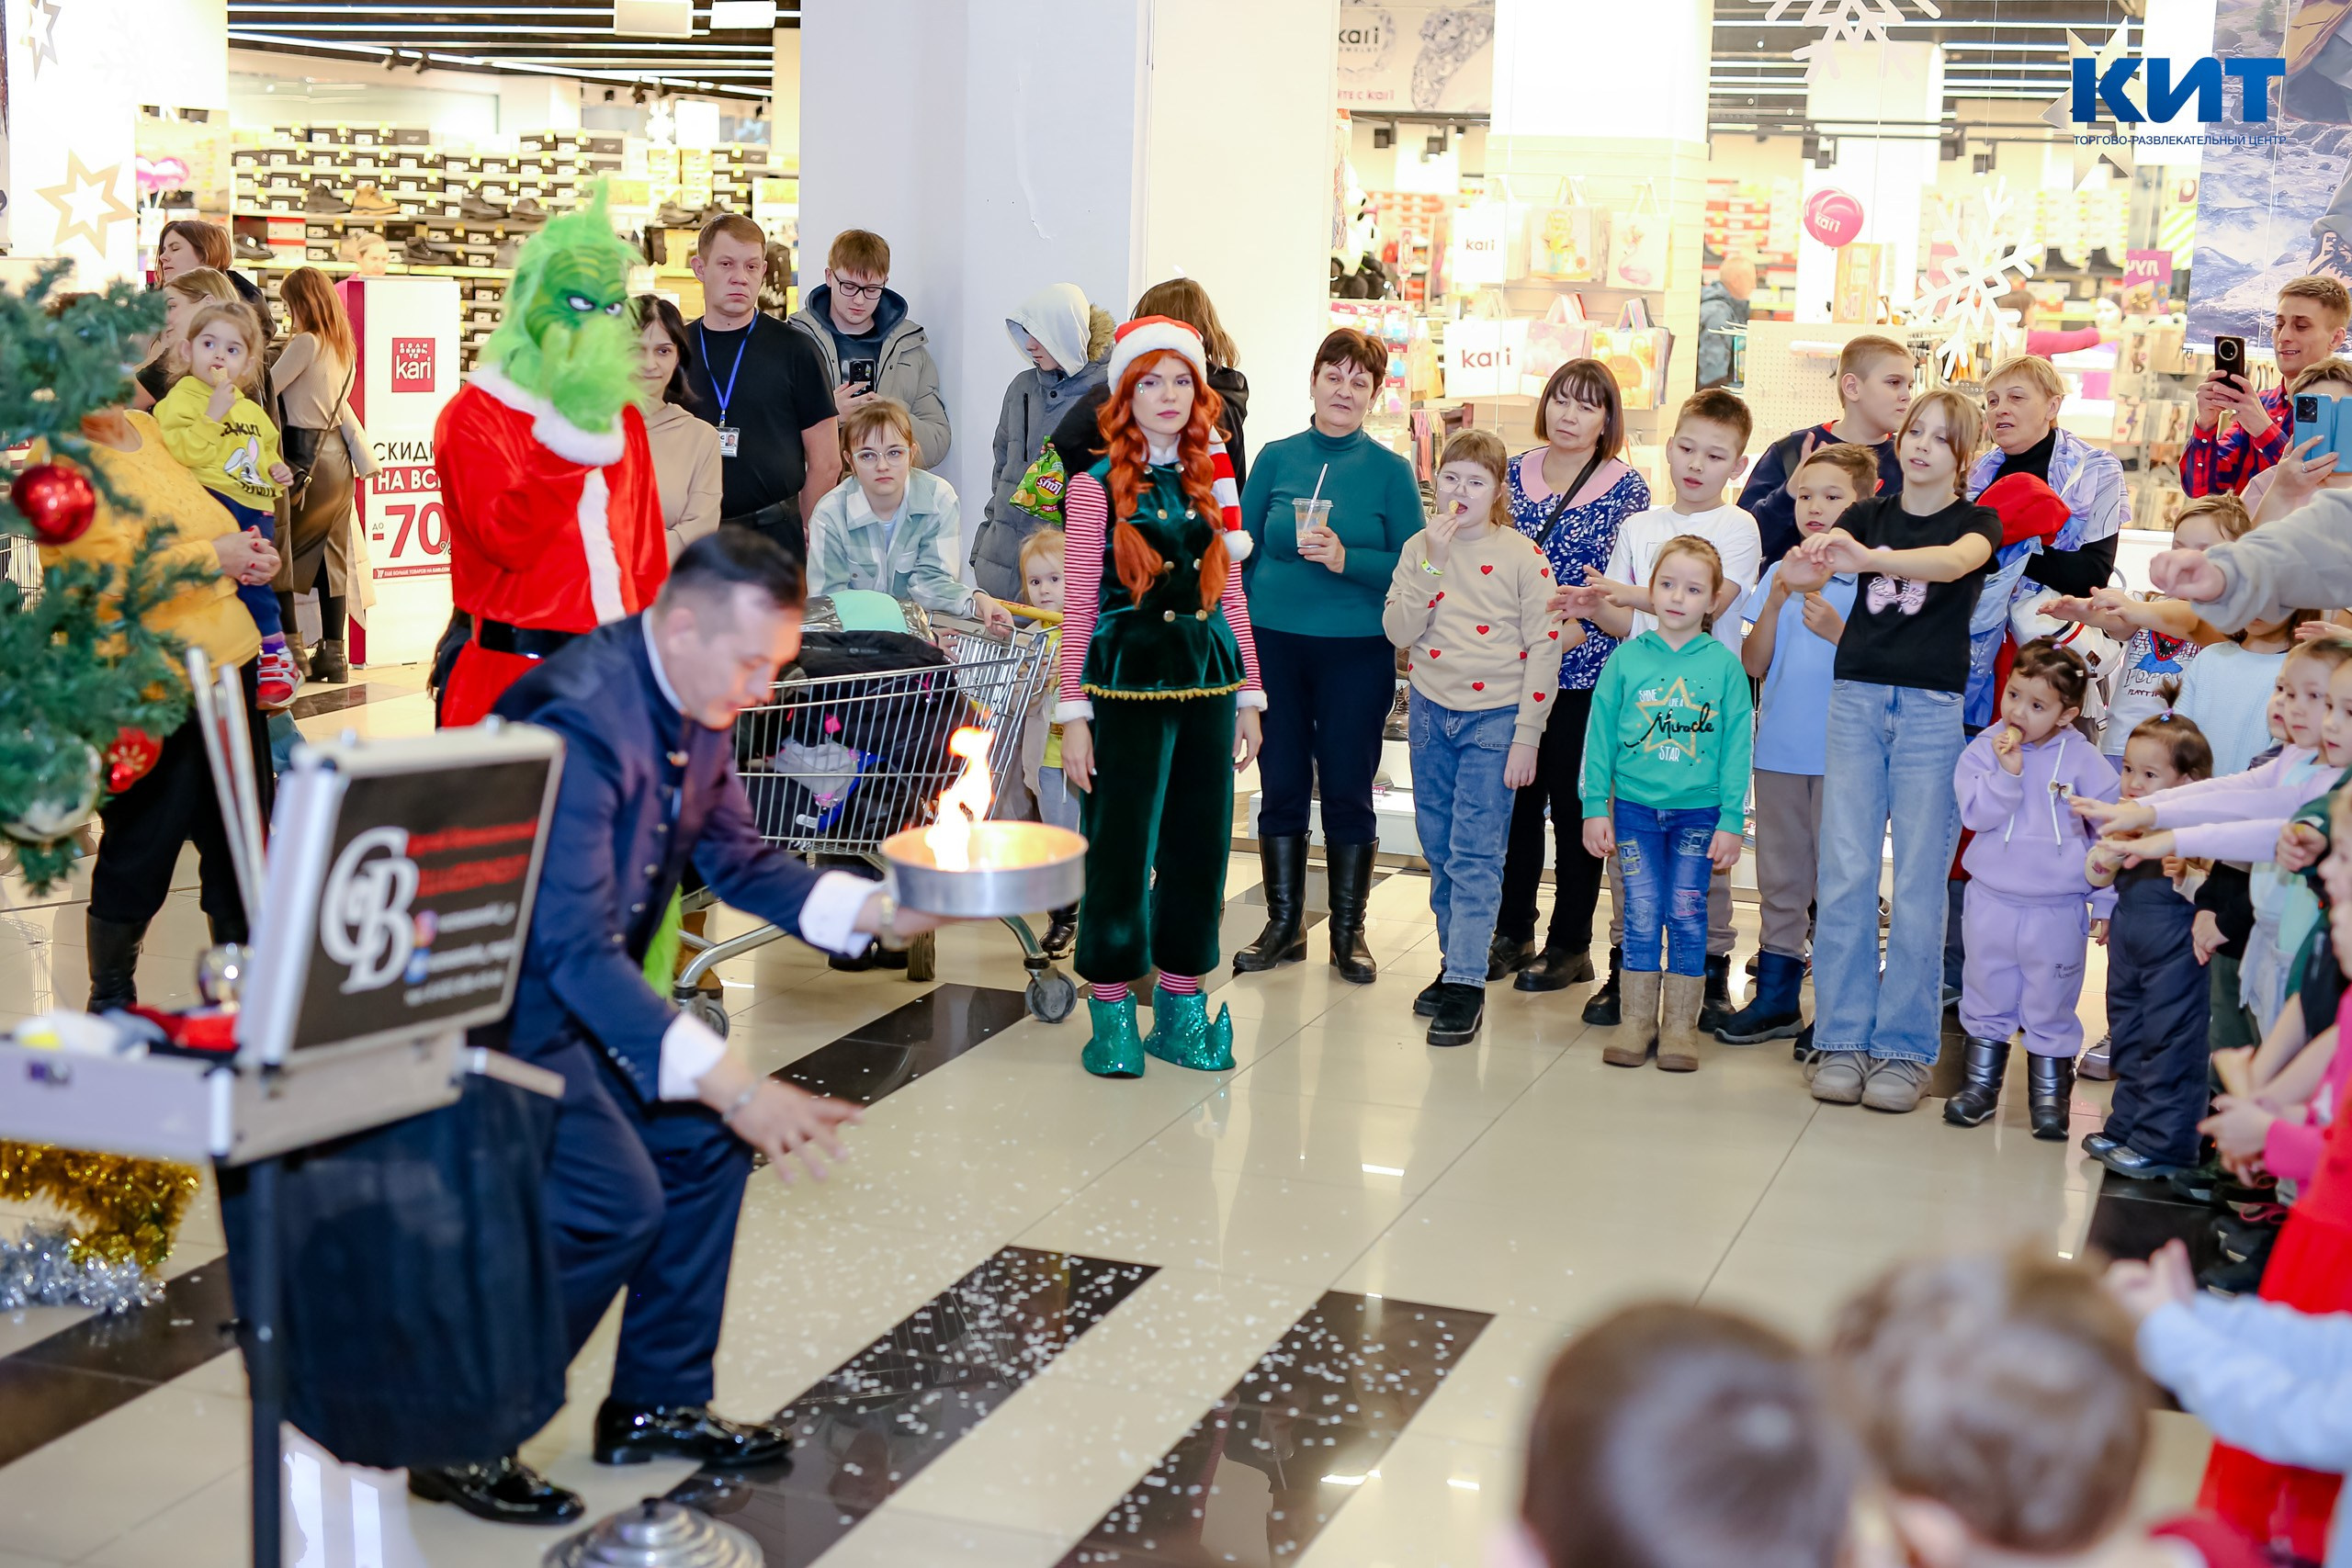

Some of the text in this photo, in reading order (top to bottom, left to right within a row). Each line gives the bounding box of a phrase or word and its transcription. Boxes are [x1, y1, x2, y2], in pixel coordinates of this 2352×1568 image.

[396, 355, 431, 380] kari
[1462, 347, 1510, 367] kari
[378, 469, 405, 491] НА
[1638, 689, 1658, 702] SHINE
[1623, 702, 1714, 748] Miracle
[1658, 745, 1680, 761] STAR
